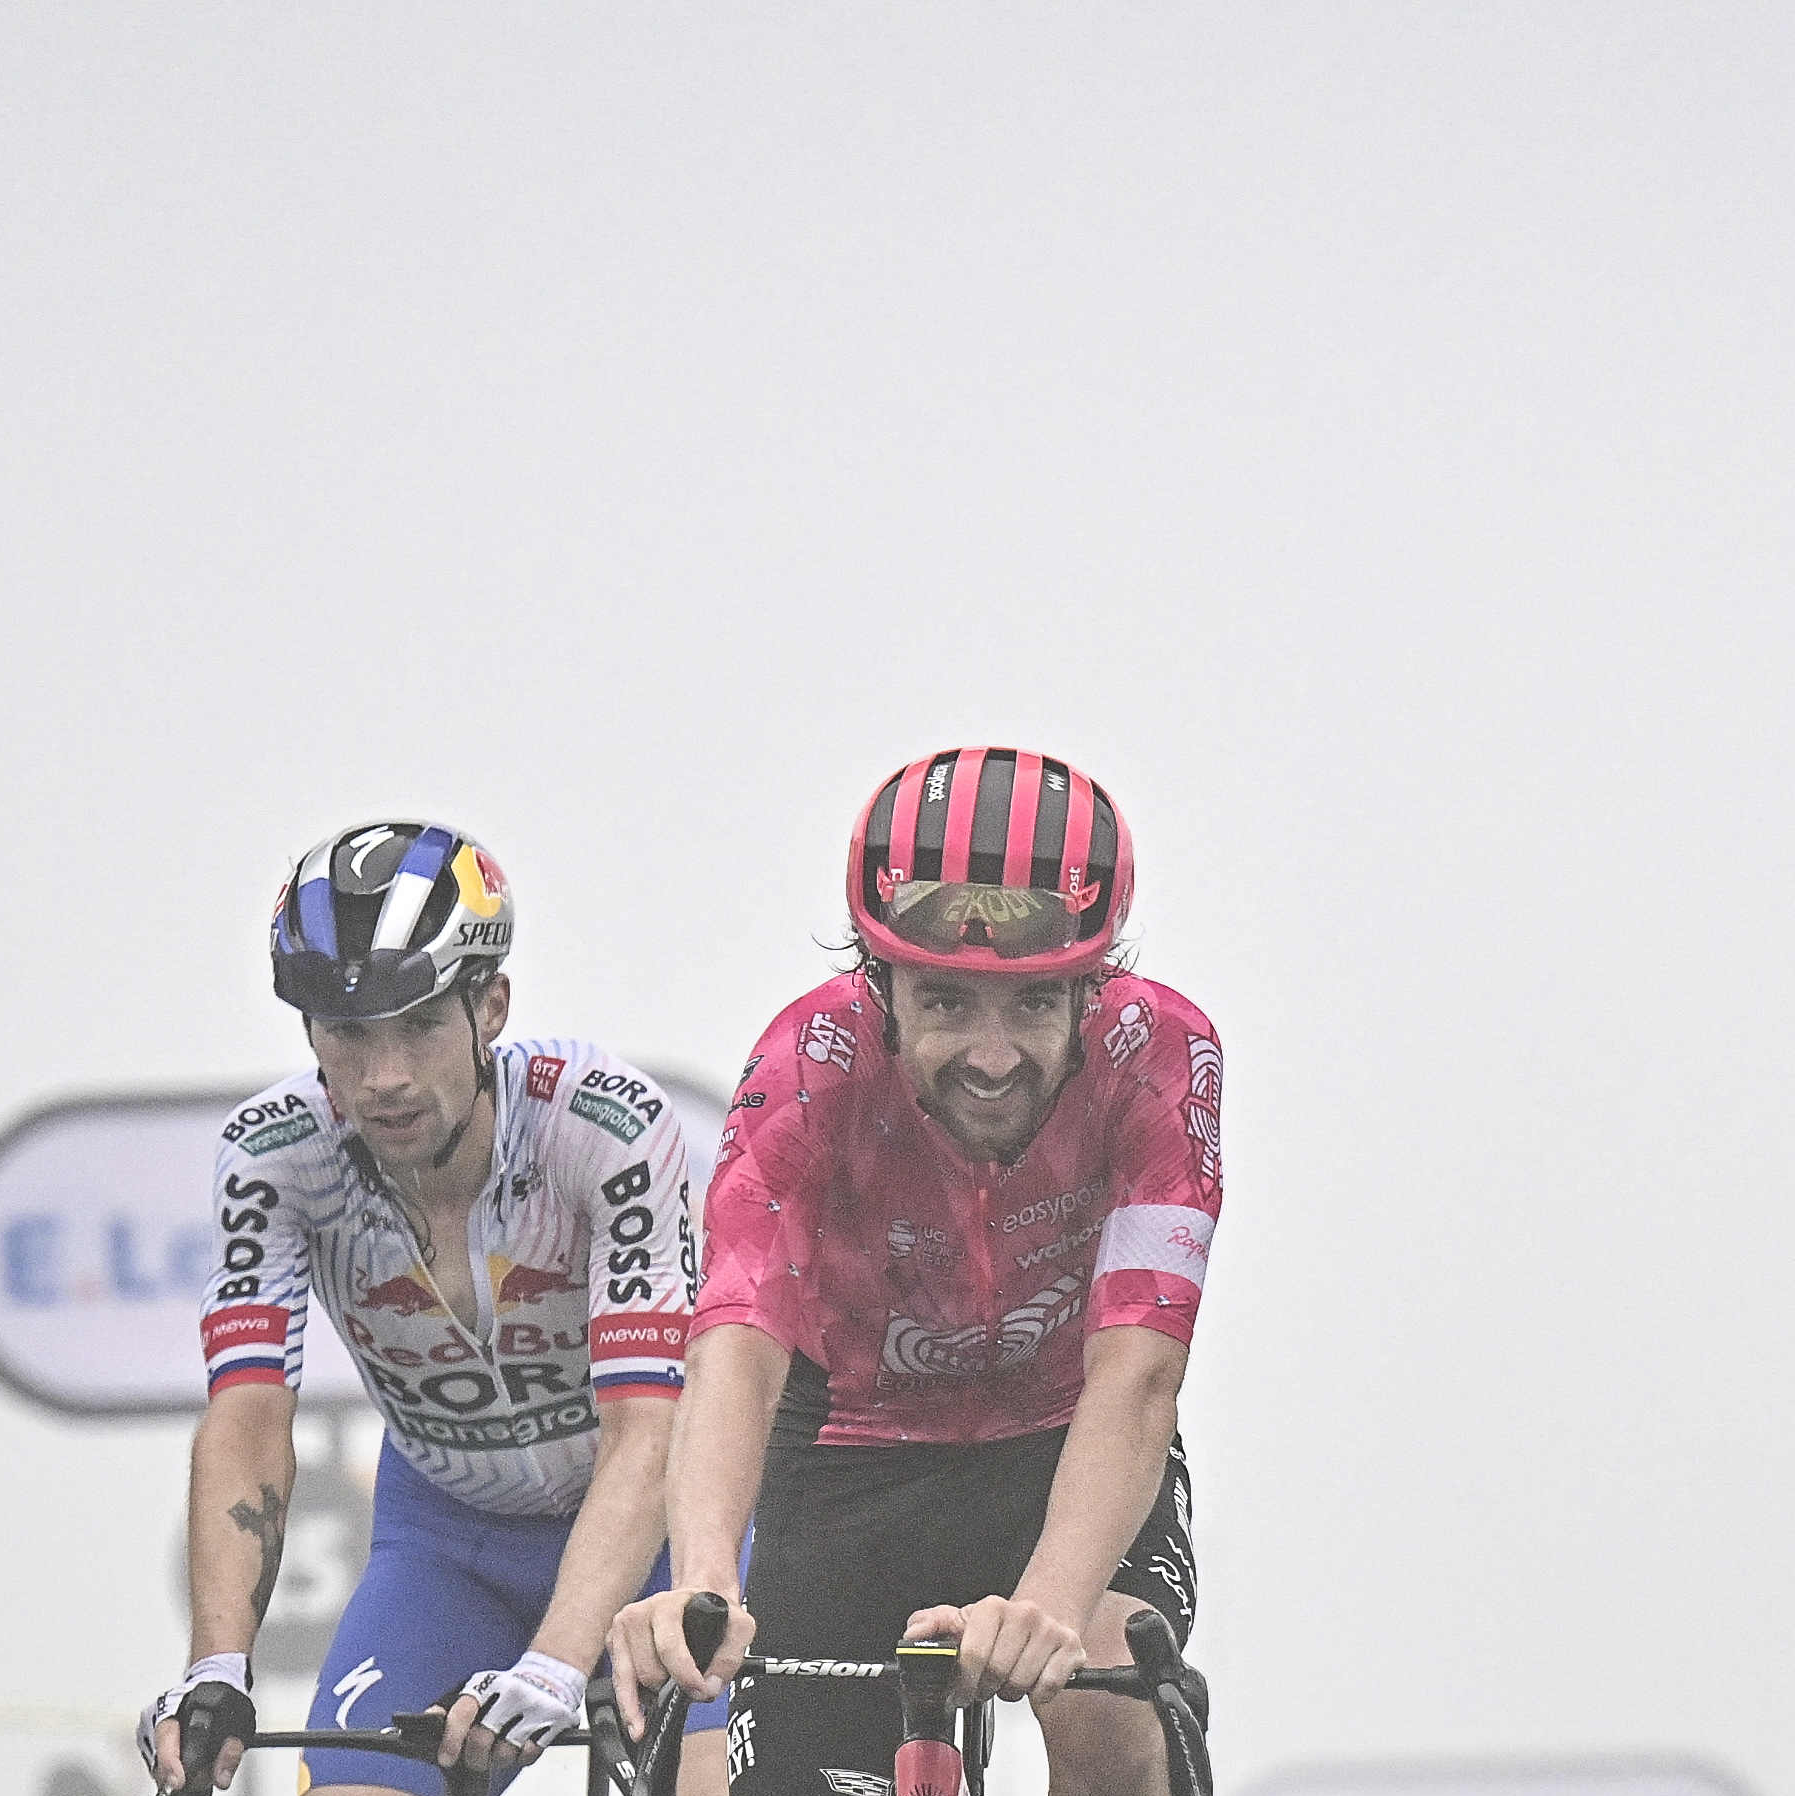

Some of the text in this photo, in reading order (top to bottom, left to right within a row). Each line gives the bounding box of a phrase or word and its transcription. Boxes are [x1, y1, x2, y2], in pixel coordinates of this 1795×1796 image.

[221, 1093, 307, 1143] BORA
[581, 1069, 664, 1124] BORA
[216, 1173, 279, 1301] BOSS
[600, 1160, 654, 1305] BOSS
[501, 1322, 591, 1357] Bu
[366, 1362, 590, 1414] BOR
[404, 1404, 599, 1445] hansgro
